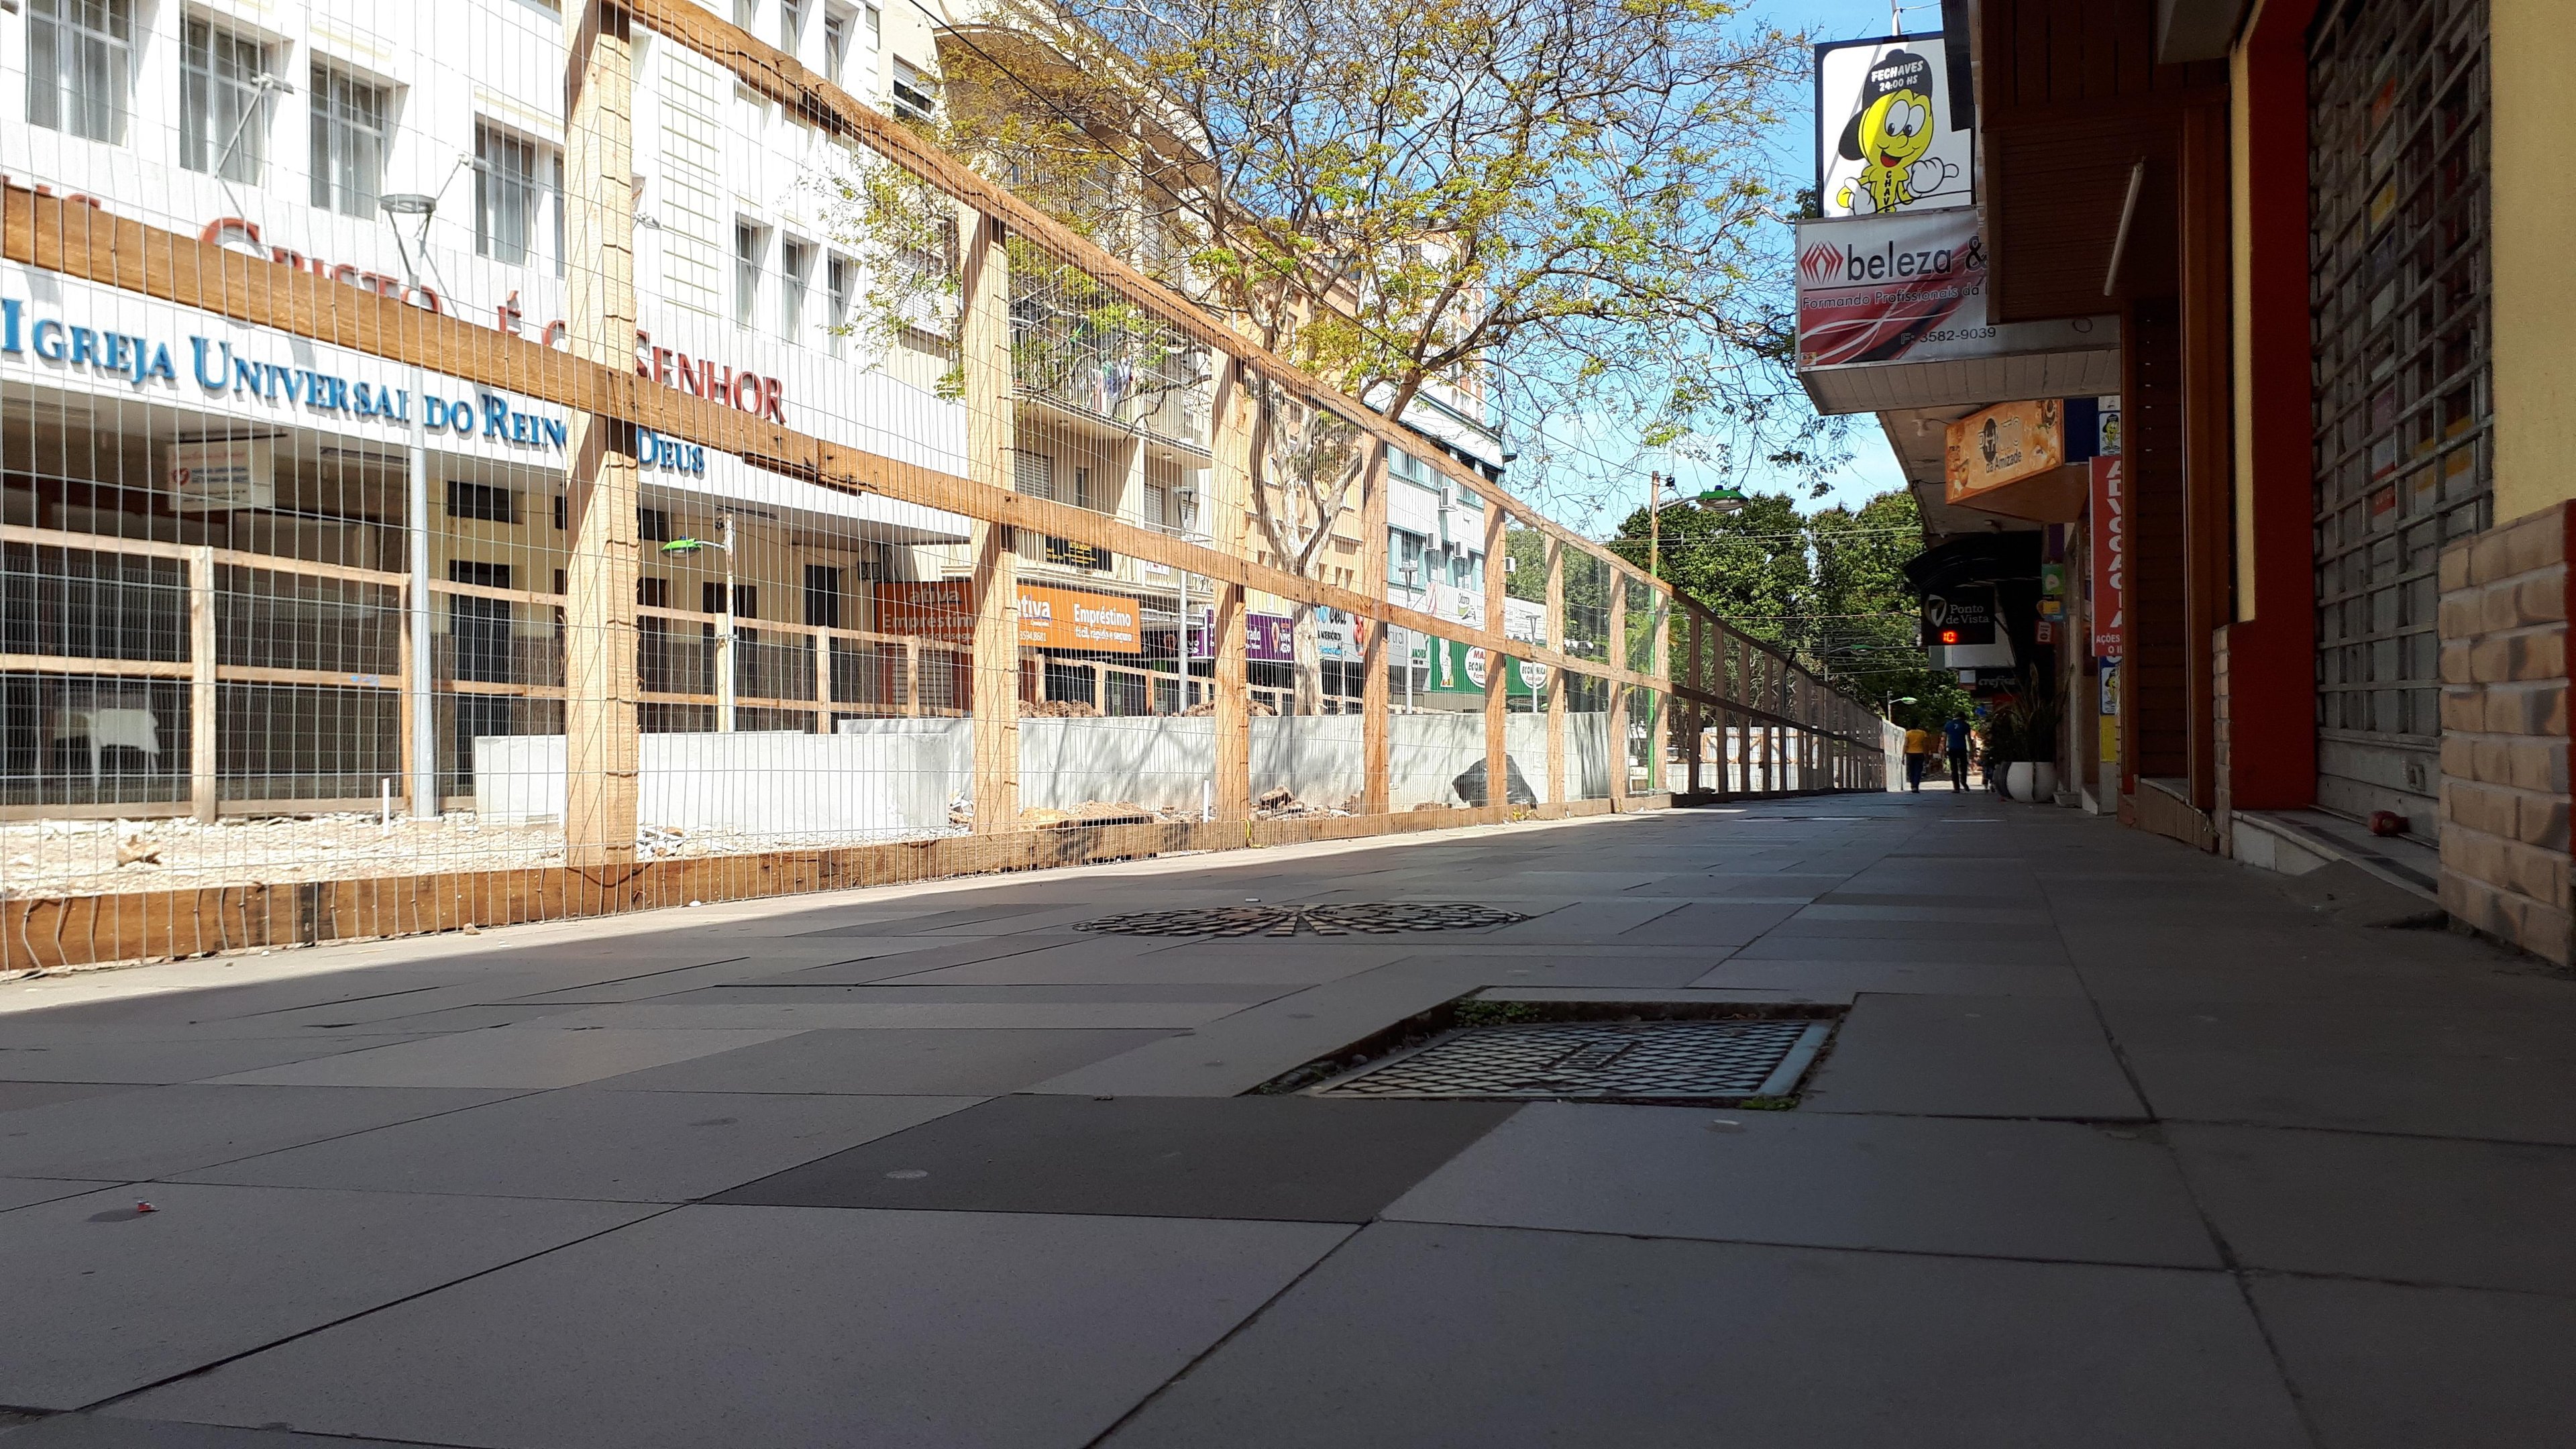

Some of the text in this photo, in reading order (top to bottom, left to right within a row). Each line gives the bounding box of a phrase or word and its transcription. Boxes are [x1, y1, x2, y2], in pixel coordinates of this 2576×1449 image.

[1871, 60, 1924, 83] FECHAVES
[1879, 74, 1919, 92] 24:00 HS
[1847, 235, 1988, 281] beleza &
[1802, 282, 1980, 310] Formando Profissionais da
[1919, 327, 1996, 343] 3582-9039
[0, 298, 705, 473] IGREJA UNIVERSAL DO REIN DEUS
[1994, 448, 2022, 471] Amizade
[909, 586, 961, 603] ativa
[1073, 602, 1132, 629] Empréstimo
[1949, 604, 1984, 614] Ponto
[883, 611, 973, 632] Empréstim
[1945, 615, 1990, 625] de Vista
[951, 633, 973, 642] segu
[1246, 627, 1260, 641] rado
[2095, 633, 2121, 645] AÇÕES
